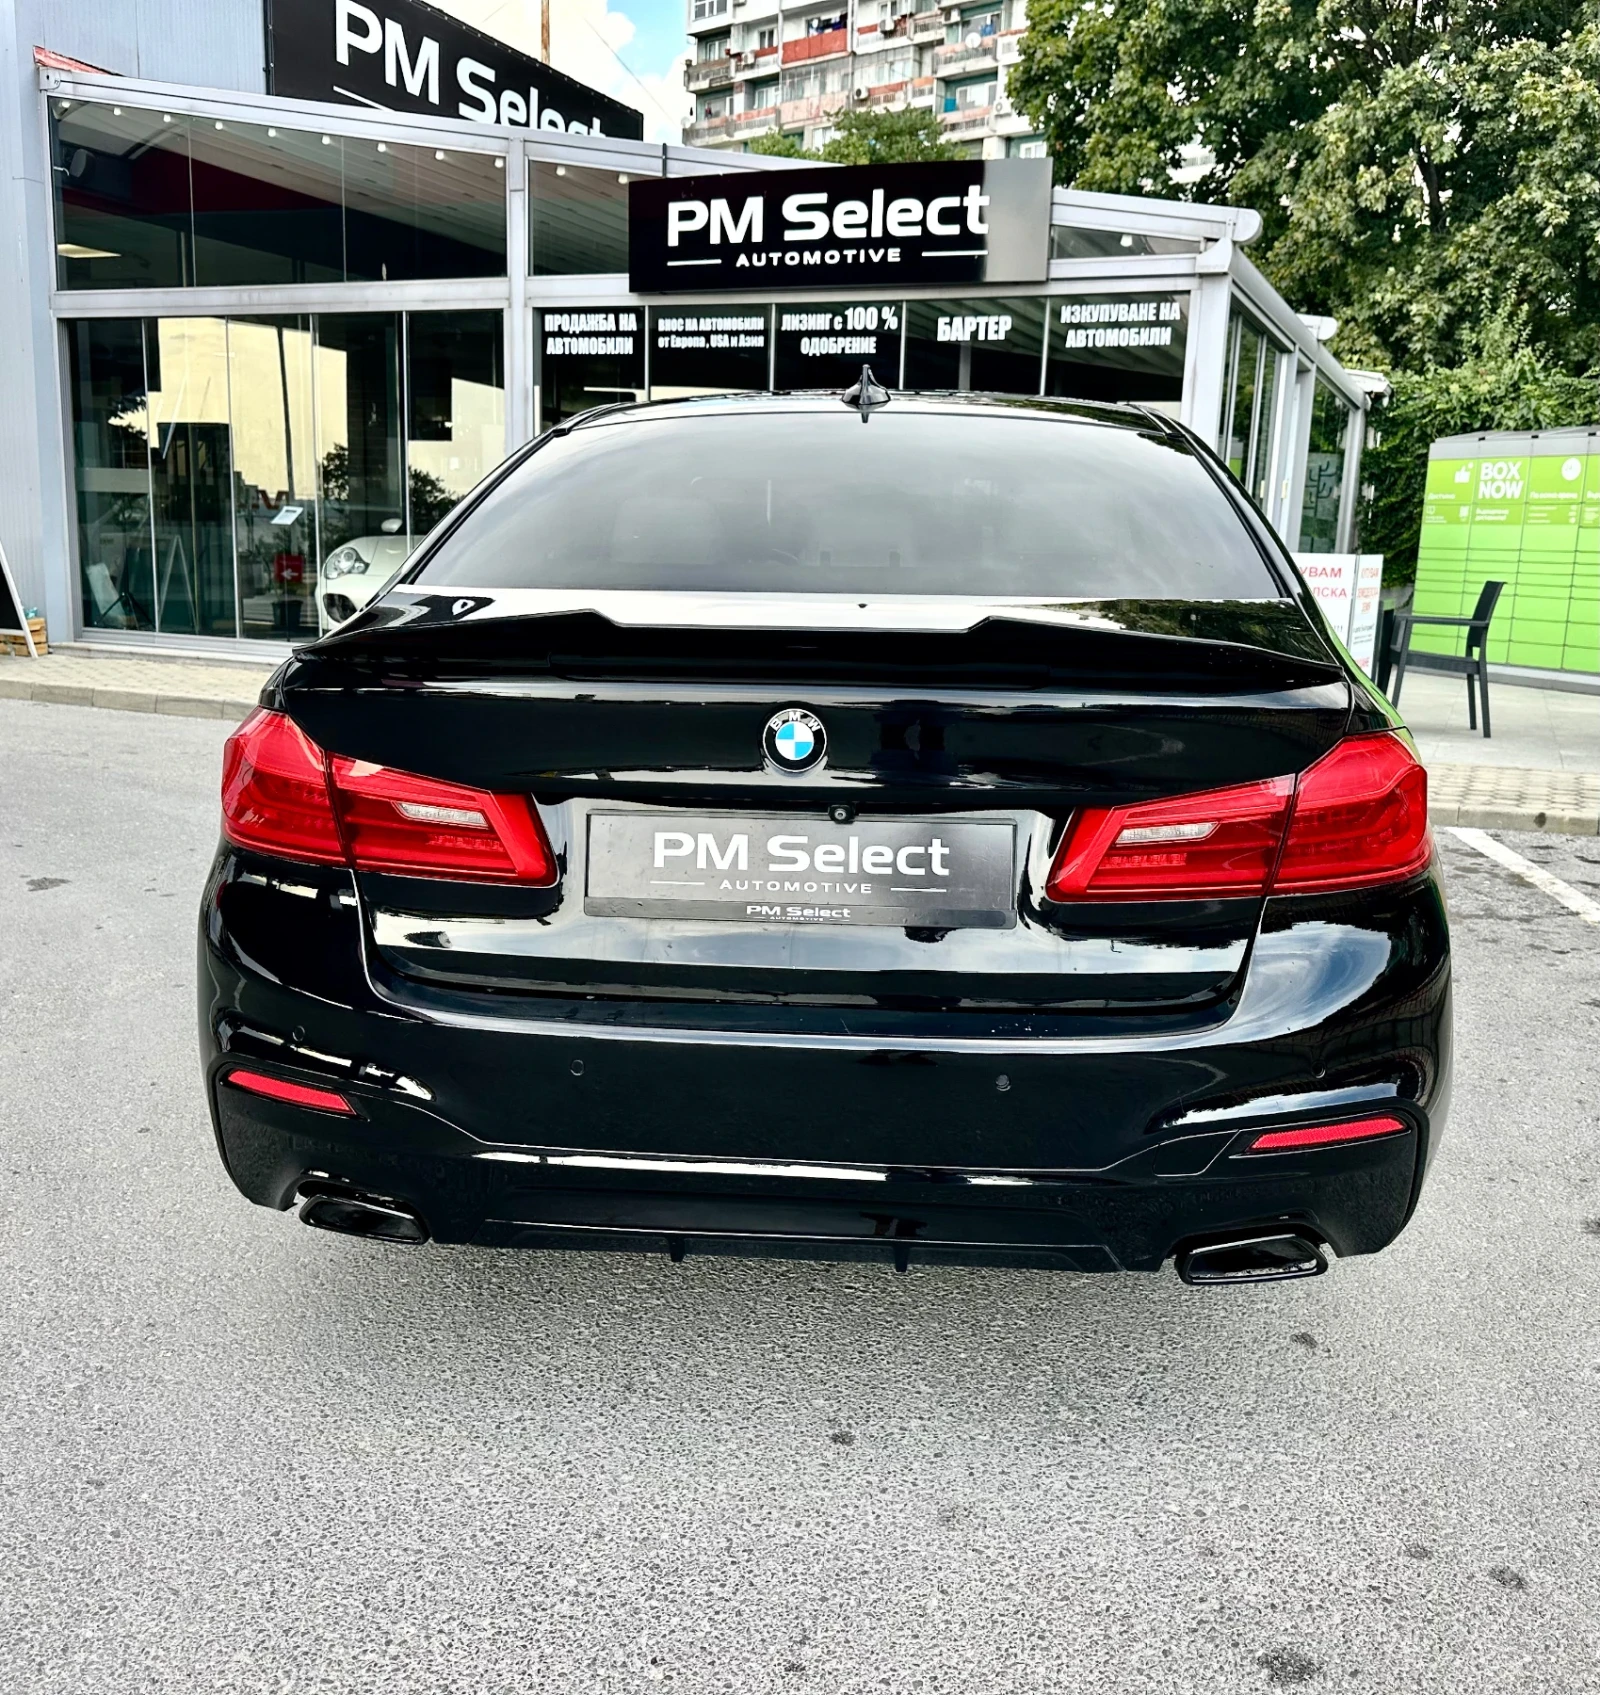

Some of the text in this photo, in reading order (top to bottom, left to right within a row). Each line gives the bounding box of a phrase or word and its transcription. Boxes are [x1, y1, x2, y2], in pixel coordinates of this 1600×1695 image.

[335, 0, 440, 105] PM
[667, 184, 990, 247] PM Select
[735, 248, 901, 268] AUTOMOTIVE
[781, 305, 899, 331] ЛИЗИНГ с 100 %
[1060, 302, 1181, 324] ИЗКУПУВАНЕ НА
[544, 313, 637, 334] ПРОДАЖБА НА
[657, 316, 765, 332] ВНОС НА АВТОМОБИЛИ
[936, 314, 1013, 342] БАРТЕР
[546, 336, 634, 355] АВТОМОБИЛИ
[657, 336, 669, 348] от
[710, 334, 729, 347] USA
[730, 336, 738, 347] и
[738, 334, 765, 347] Азия
[800, 336, 877, 356] ОДОБРЕНИЕ
[1065, 326, 1172, 348] АВТОМОБИЛИ
[1480, 461, 1522, 480] BOX
[1478, 480, 1524, 499] NOW
[769, 711, 821, 732] BMW
[653, 831, 950, 876] PM Select
[719, 878, 873, 895] AUTOMOTIVE
[746, 905, 851, 918] PM Select
